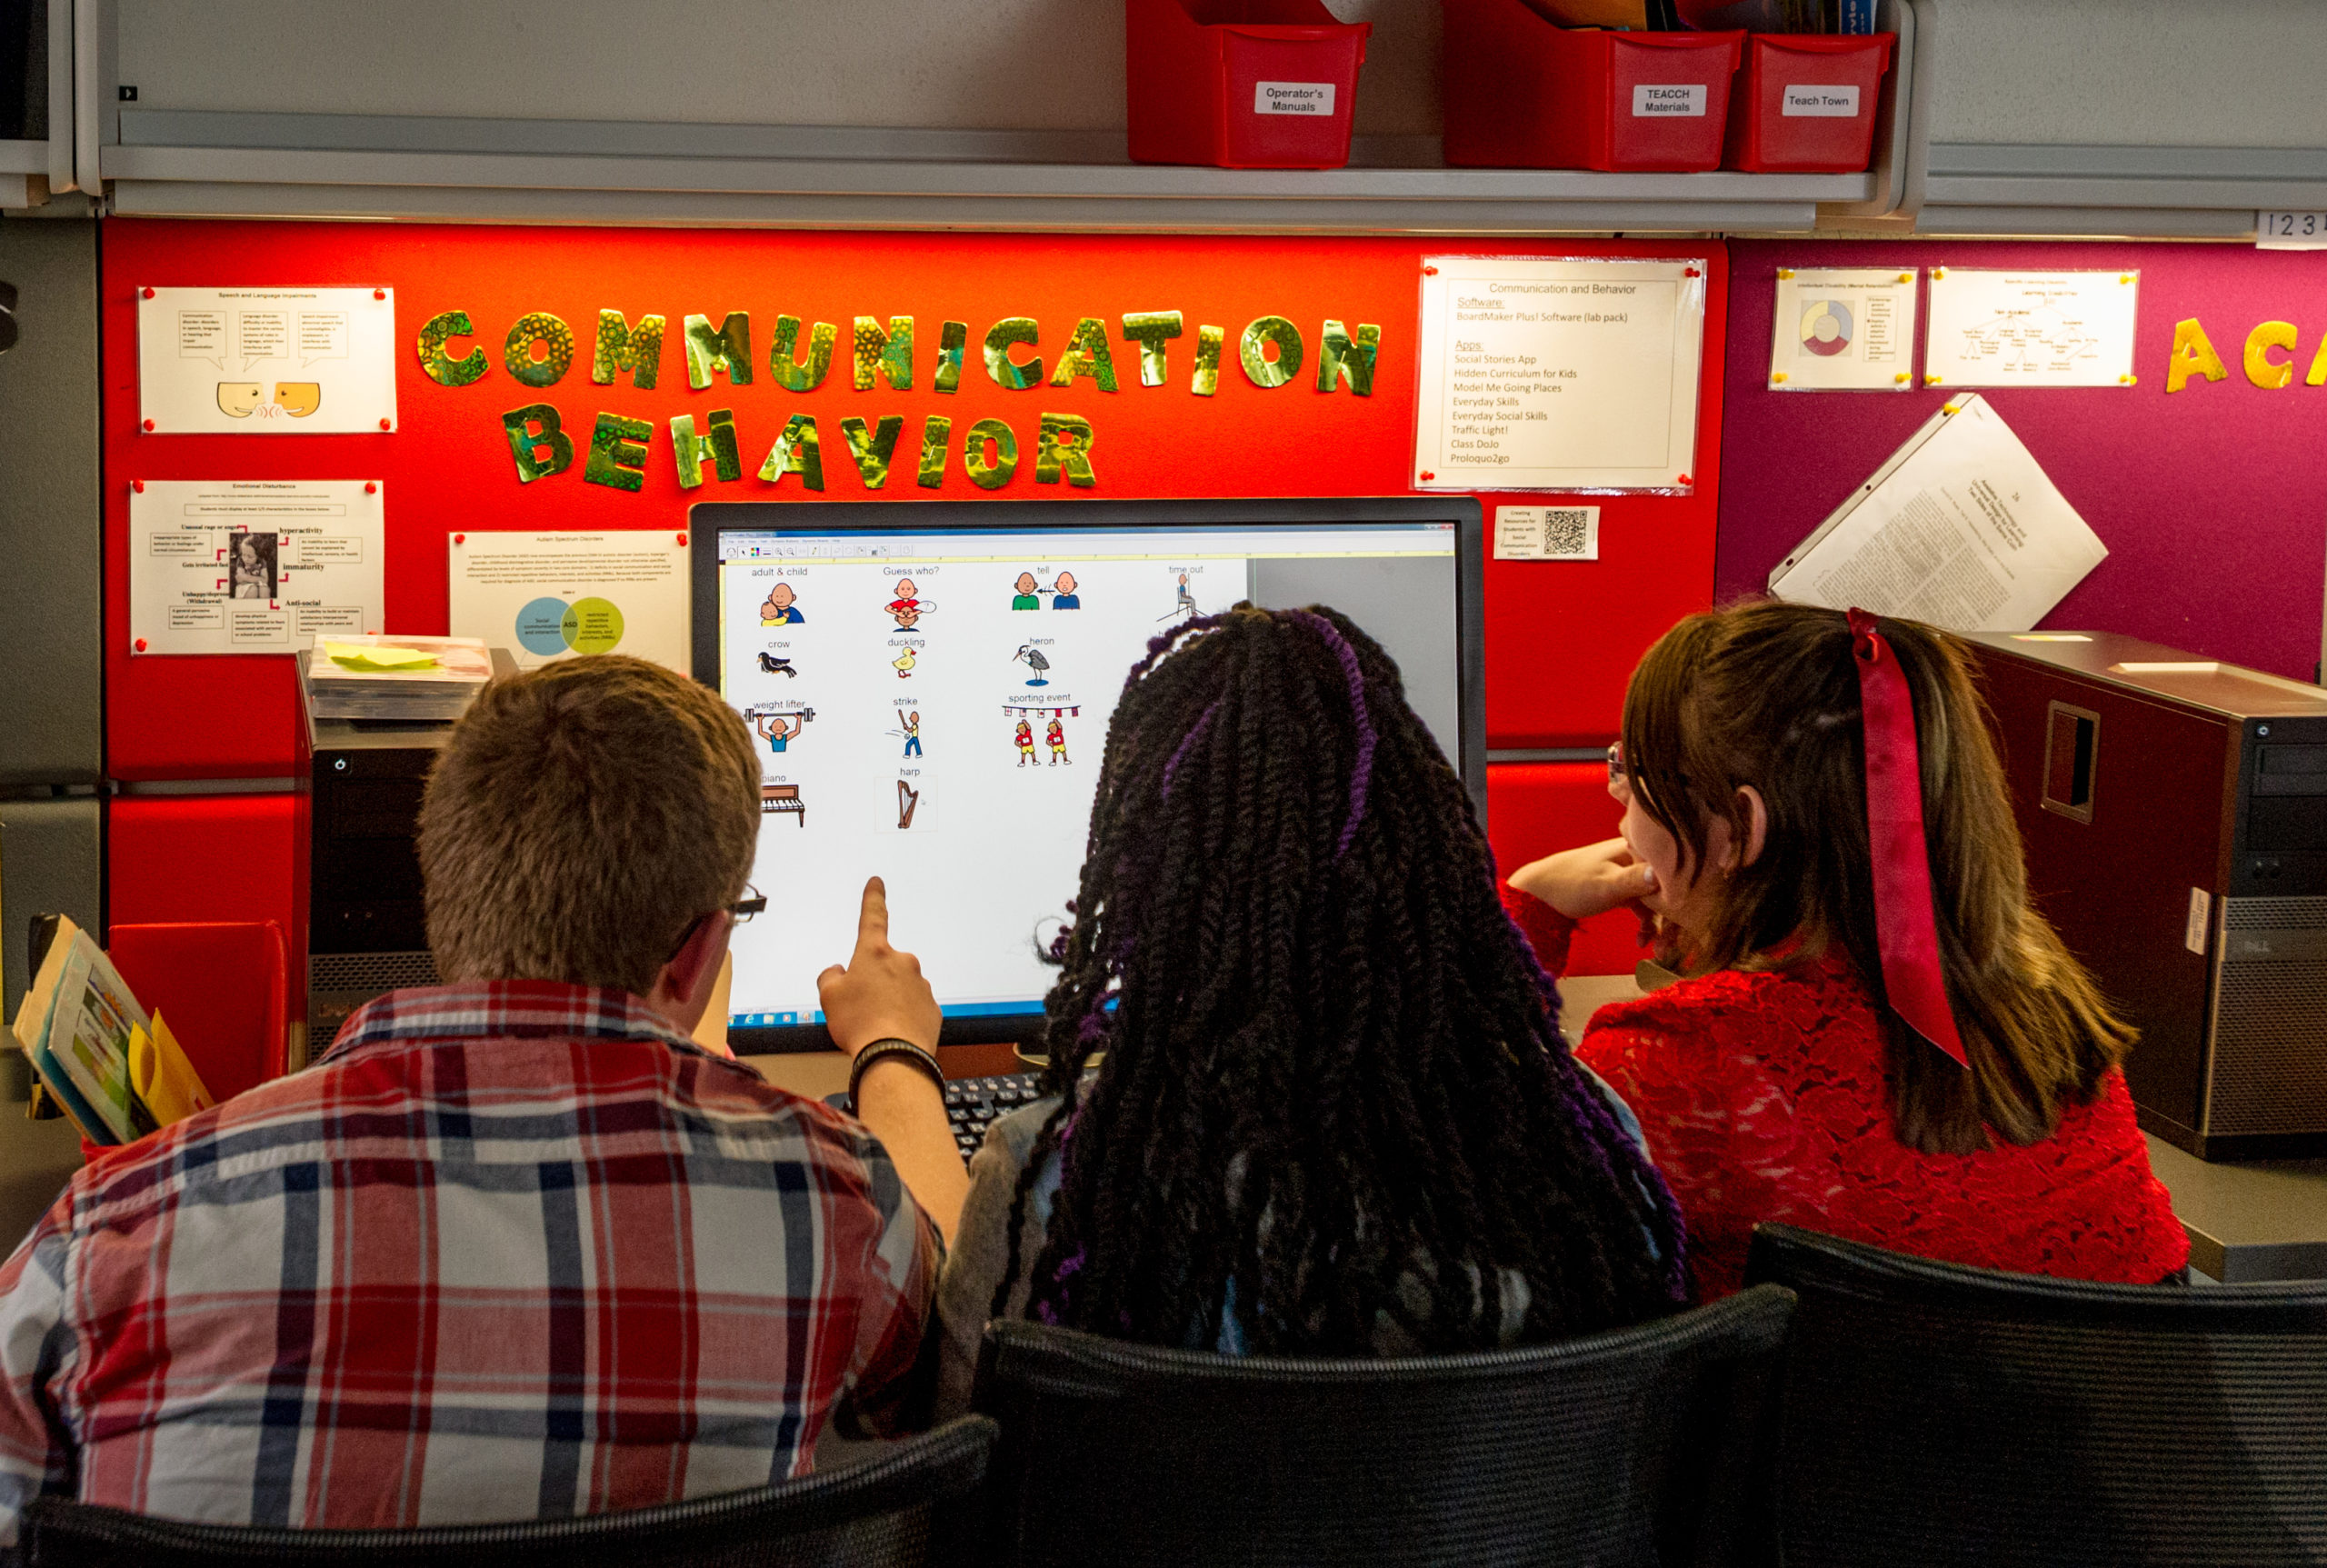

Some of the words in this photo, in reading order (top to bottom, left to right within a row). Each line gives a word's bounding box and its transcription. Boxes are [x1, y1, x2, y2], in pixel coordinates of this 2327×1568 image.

[1266, 88, 1323, 99] Operator's
[1648, 89, 1690, 99] TEACCH
[1789, 96, 1819, 105] Teach
[1822, 96, 1849, 105] Town
[1272, 101, 1315, 111] Manuals
[1645, 103, 1690, 112] Materials
[2281, 215, 2293, 235] 2
[2302, 215, 2315, 235] 3
[1489, 284, 1568, 293] Communication
[1571, 284, 1590, 294] and
[1592, 285, 1636, 294] Behavior
[1458, 297, 1505, 309] Software:
[1457, 312, 1513, 321] BoardMaker
[1516, 312, 1538, 321] Plus!
[1541, 312, 1582, 322] Software
[1584, 313, 1601, 323] (lab
[1603, 313, 1628, 324] pack)
[1455, 340, 1484, 352] Apps:
[416, 308, 1381, 397] COMMUNICATION
[1455, 355, 1481, 363] Social
[1484, 355, 1516, 364] Stories
[1518, 355, 1537, 366] App
[1454, 369, 1487, 378] Hidden
[1490, 369, 1541, 378] Curriculum
[1543, 369, 1556, 378] for
[1559, 369, 1577, 378] Kids
[1454, 383, 1483, 392] Model
[1486, 383, 1501, 392] Me
[1504, 383, 1531, 394] Going
[1533, 383, 1562, 392] Places
[1453, 397, 1494, 407] Everyday
[1496, 397, 1519, 406] Skills
[1452, 411, 1494, 422] Everyday
[1496, 411, 1523, 421] Social
[1525, 411, 1548, 421] Skills
[1452, 425, 1479, 434] Traffic
[1482, 425, 1508, 436] Light!
[502, 403, 1096, 492] BEHAVIOR
[1451, 439, 1474, 449] Class
[1476, 439, 1499, 449] DoJo
[1450, 453, 1510, 465] Proloquo2go
[283, 563, 324, 571] immaturity
[777, 567, 783, 576] &
[883, 567, 912, 575] Guess
[916, 566, 939, 575] who?
[1169, 565, 1187, 574] time
[888, 638, 925, 647] duckling
[1009, 694, 1044, 704] sporting
[753, 700, 783, 711] weight
[900, 768, 920, 777] harp
